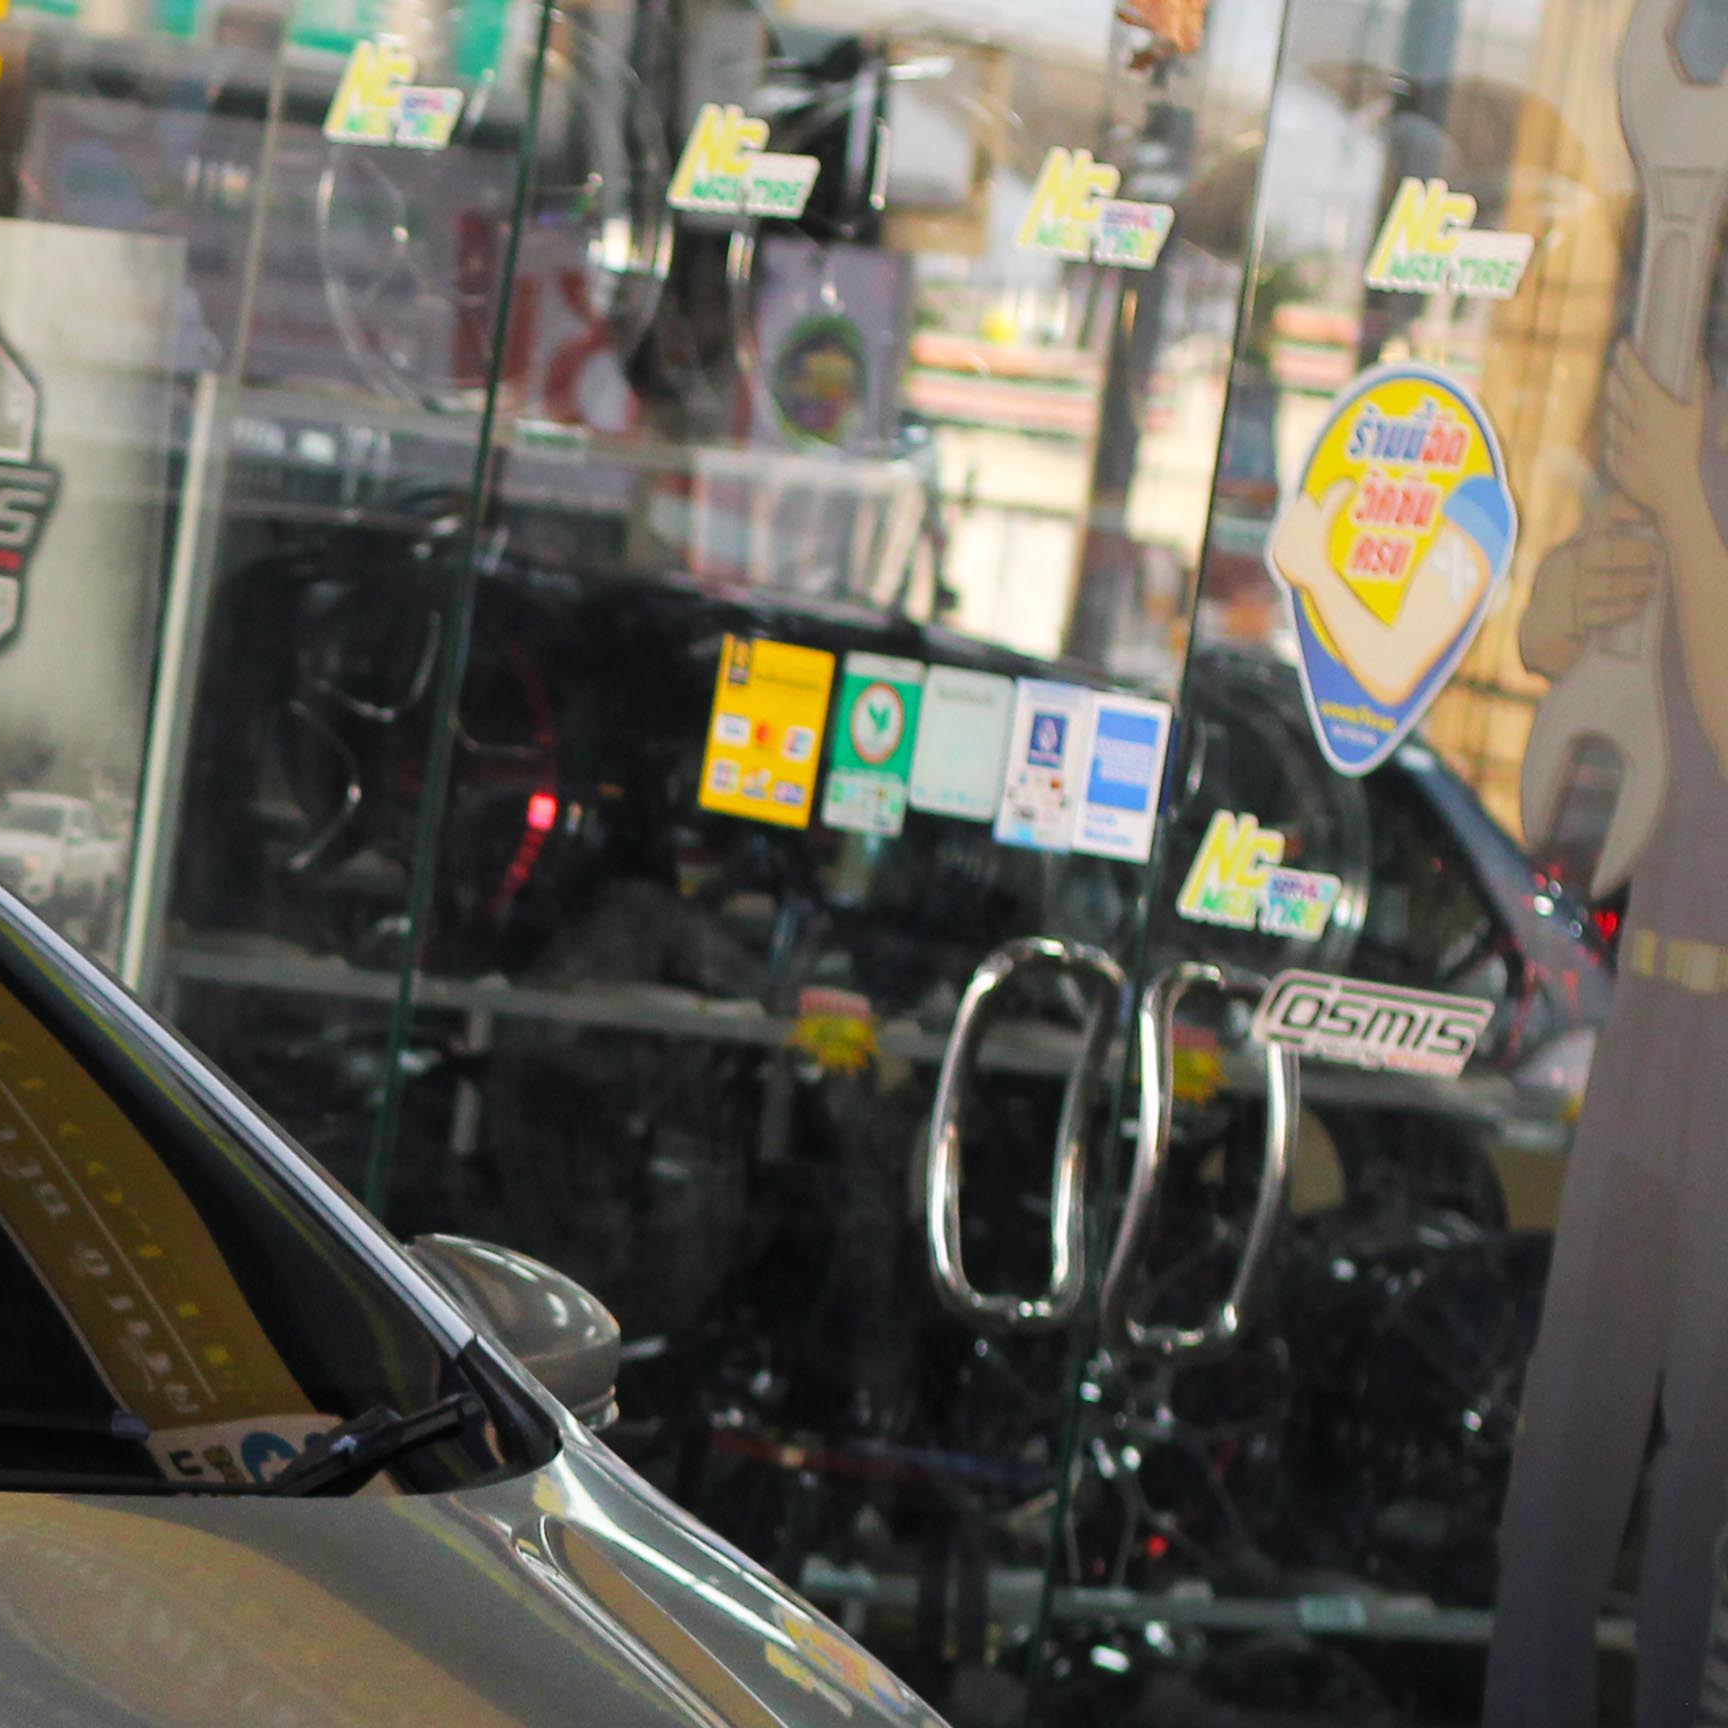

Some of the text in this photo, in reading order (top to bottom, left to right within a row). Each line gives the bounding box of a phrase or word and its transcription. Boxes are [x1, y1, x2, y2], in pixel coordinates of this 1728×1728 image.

[676, 110, 766, 198] NC
[1019, 154, 1117, 245] NC
[1372, 183, 1474, 278] NC
[1184, 820, 1282, 908] NC
